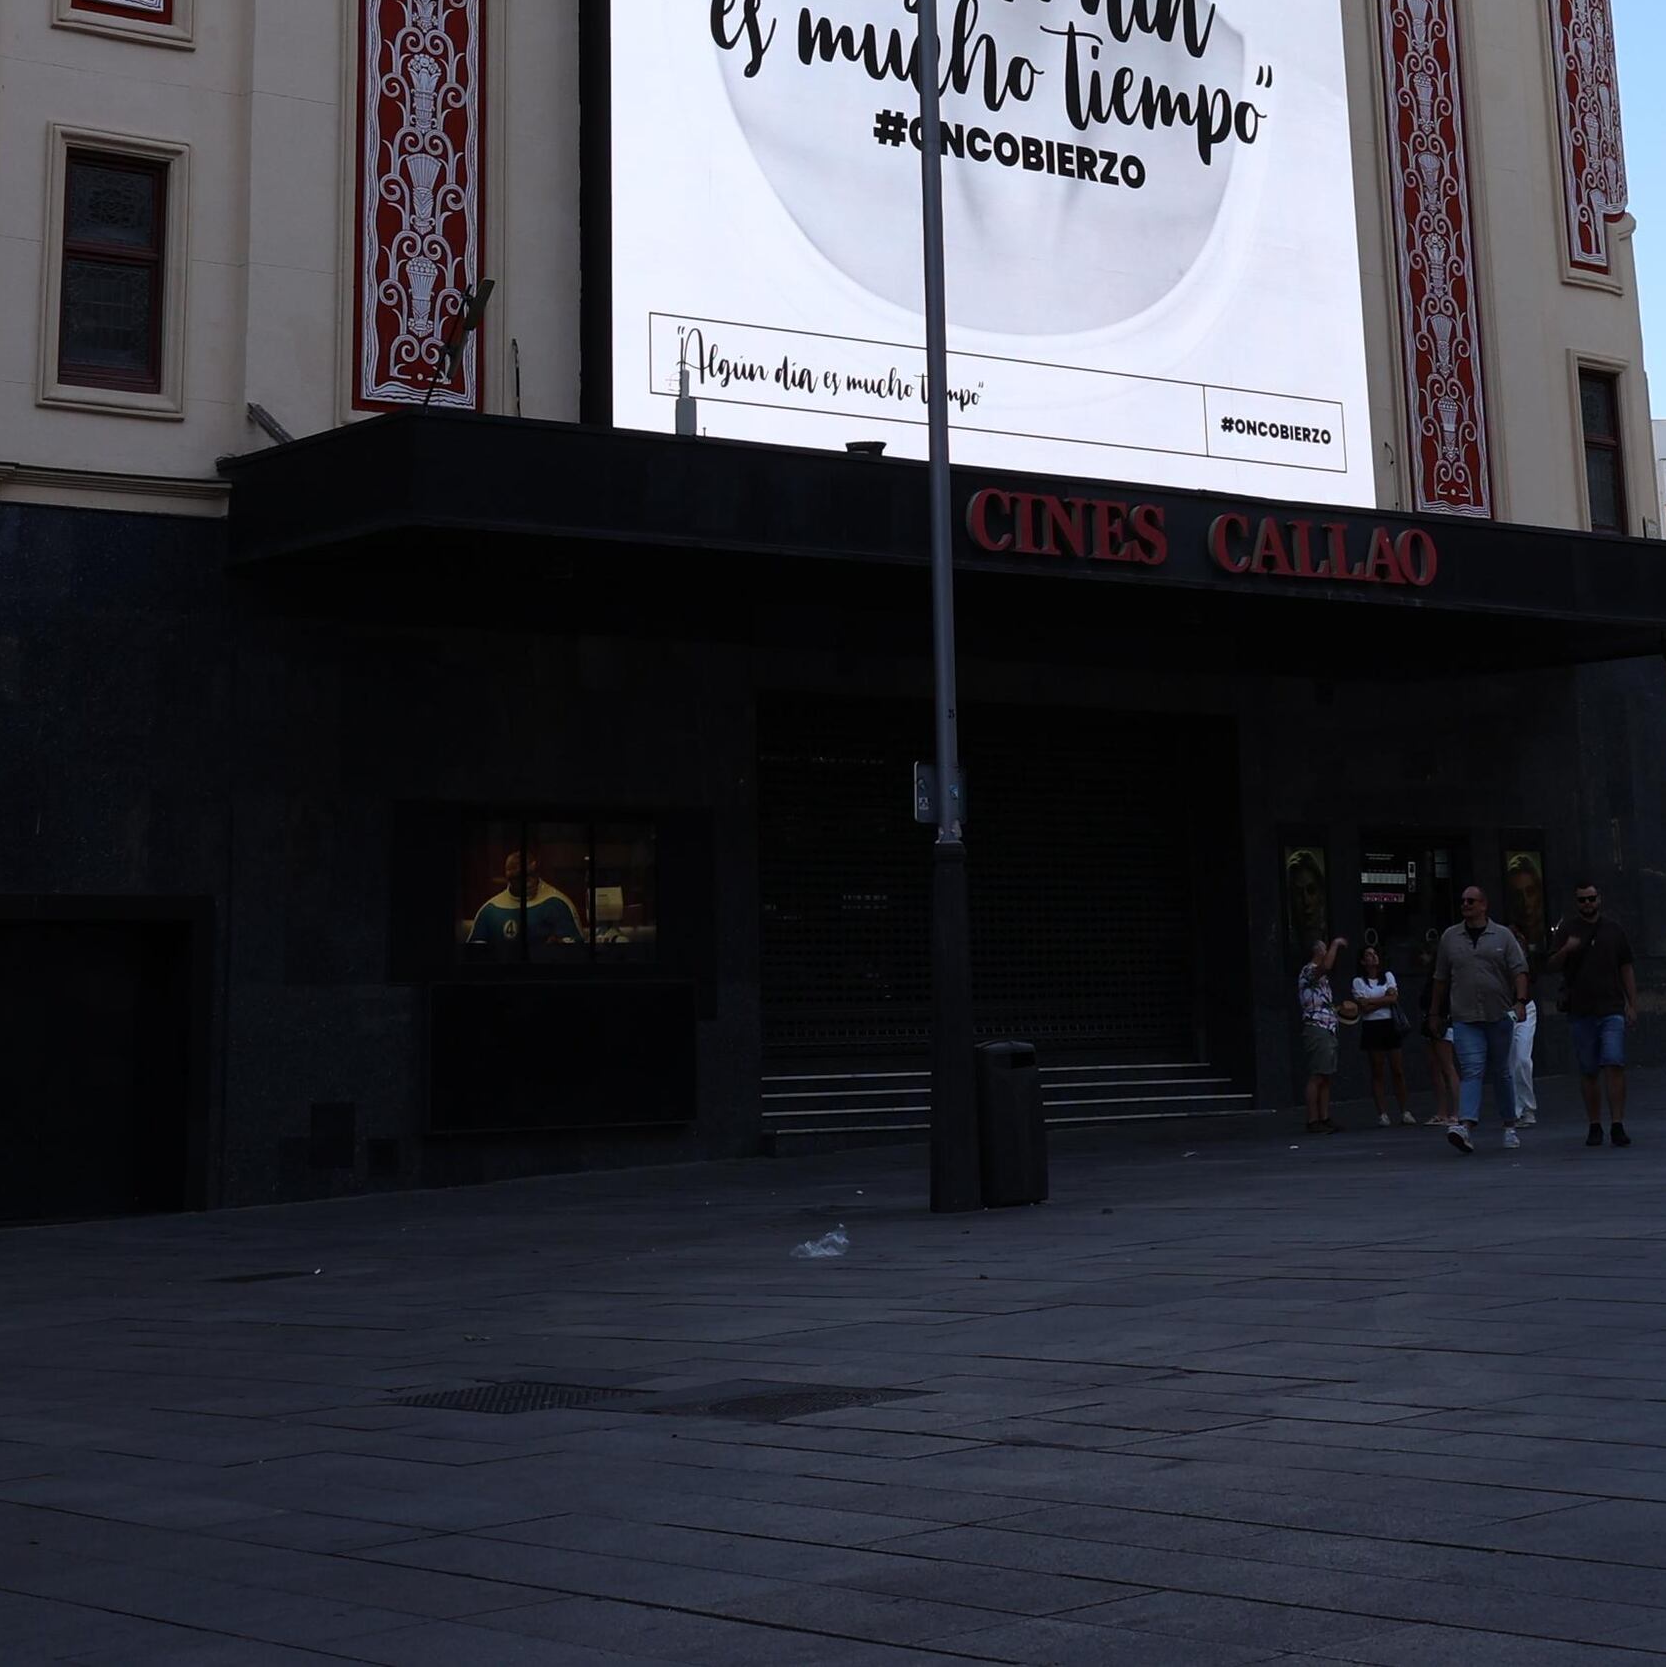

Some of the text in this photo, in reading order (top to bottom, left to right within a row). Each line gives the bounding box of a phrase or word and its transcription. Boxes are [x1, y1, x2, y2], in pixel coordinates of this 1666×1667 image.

[775, 355, 818, 394] día
[824, 371, 841, 396] es
[846, 367, 915, 400] mucho
[1221, 416, 1331, 444] #ONCOBIERZO
[966, 488, 1438, 587] CINES CALLAO
[505, 920, 517, 938] 4
